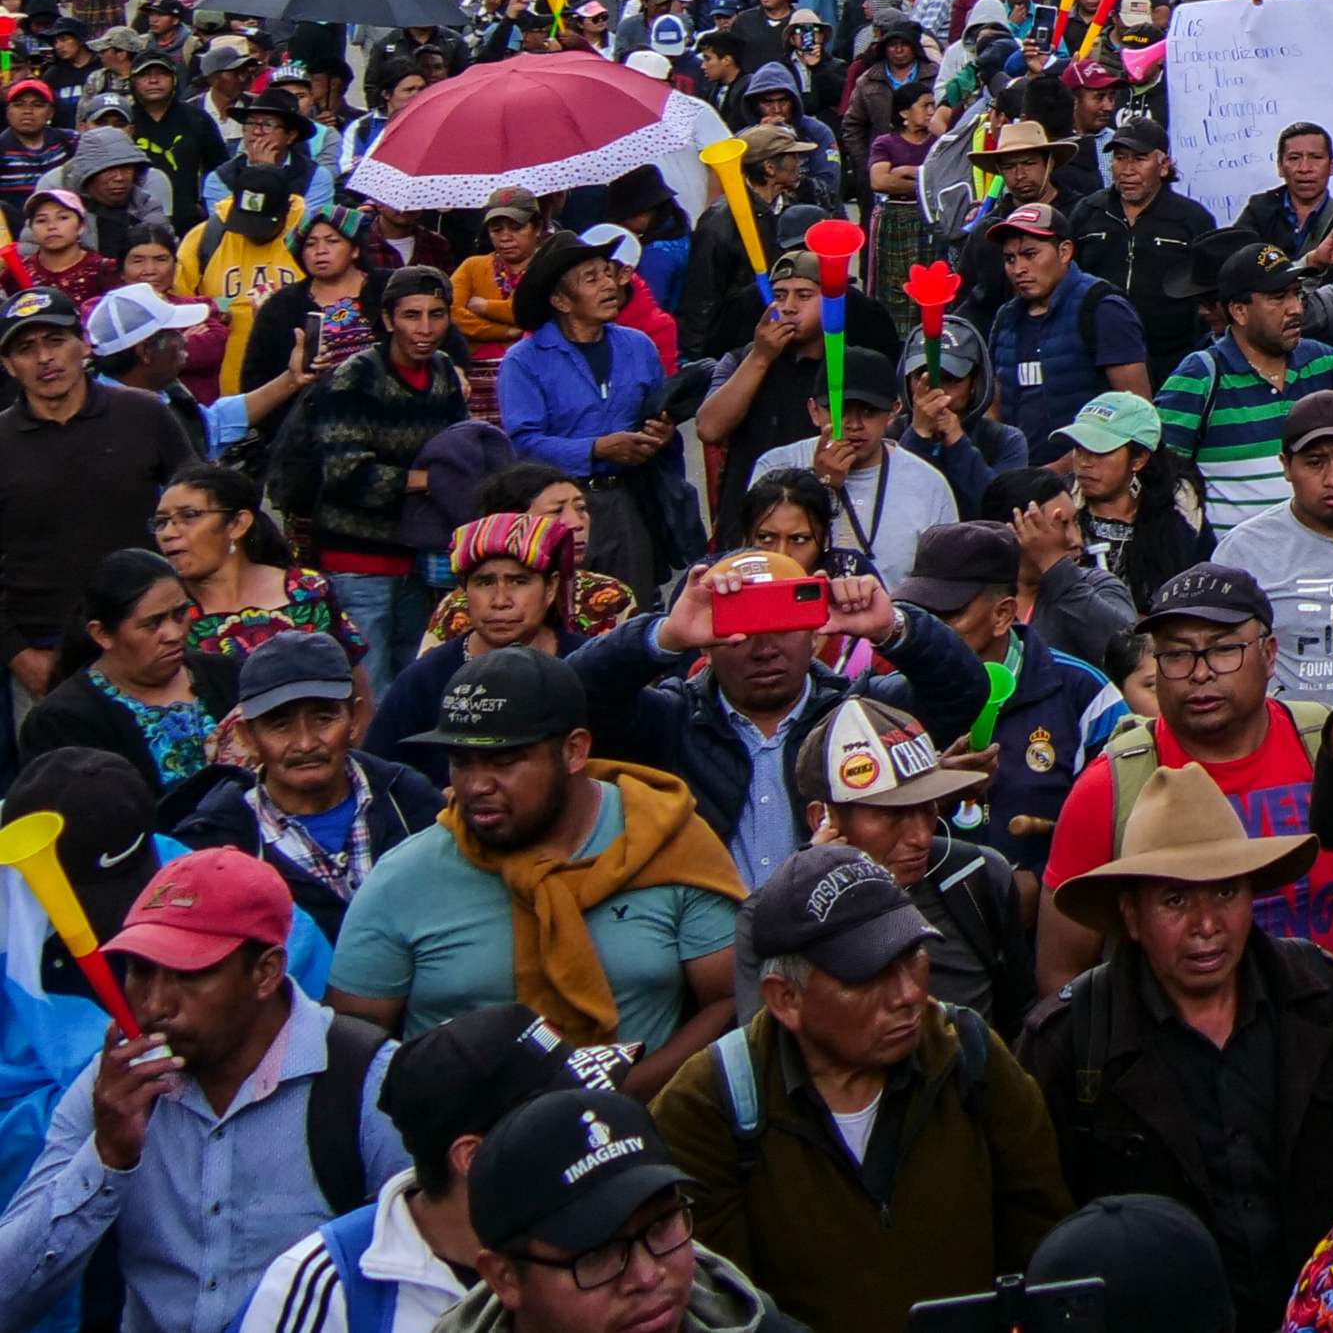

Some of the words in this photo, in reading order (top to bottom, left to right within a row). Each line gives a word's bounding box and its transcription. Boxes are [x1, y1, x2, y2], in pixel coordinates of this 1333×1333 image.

[1173, 11, 1203, 37] Nos
[564, 1139, 627, 1184] IMAGEN
[625, 1136, 644, 1153] TV
